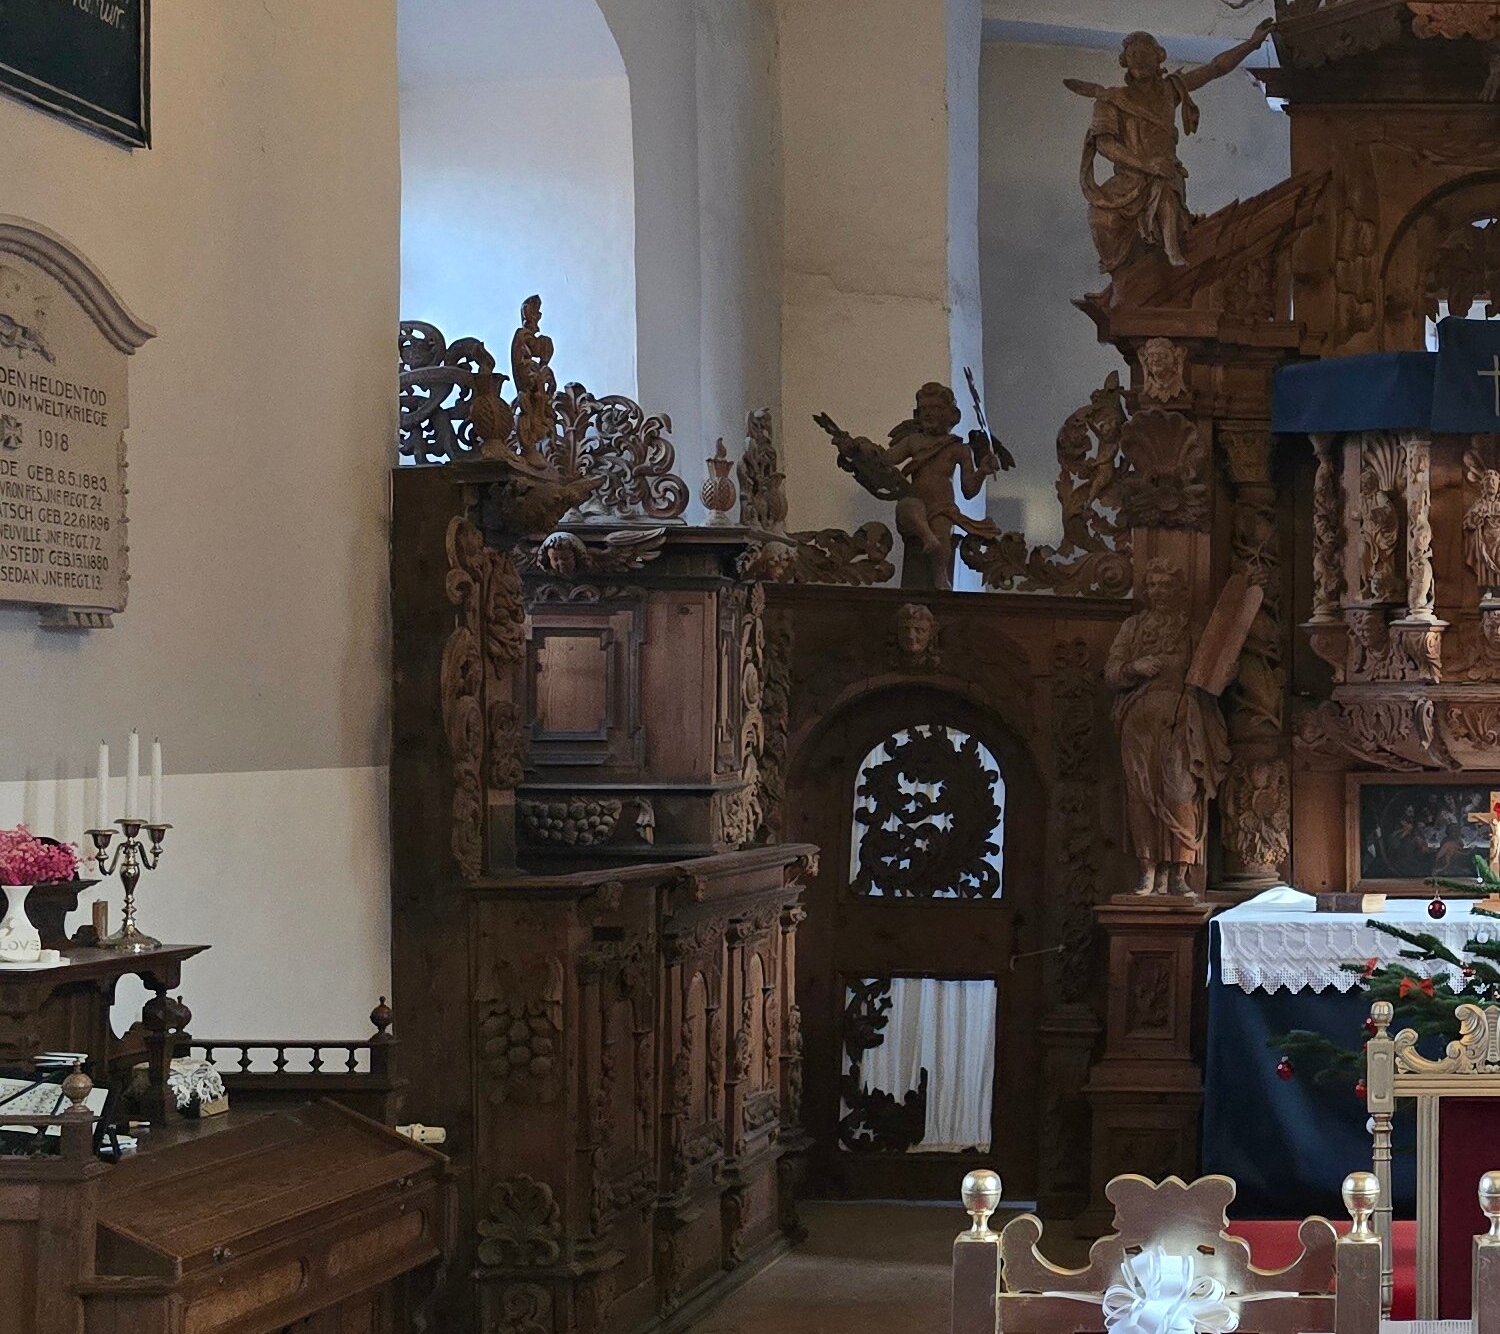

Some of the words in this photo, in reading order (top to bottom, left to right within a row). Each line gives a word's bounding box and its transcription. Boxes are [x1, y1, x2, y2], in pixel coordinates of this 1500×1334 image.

[30, 373, 107, 406] HELDENTOD
[19, 393, 33, 411] IM
[34, 396, 109, 427] WELTKRIEGE
[38, 429, 69, 452] 1918
[0, 565, 39, 585] SEDAN
